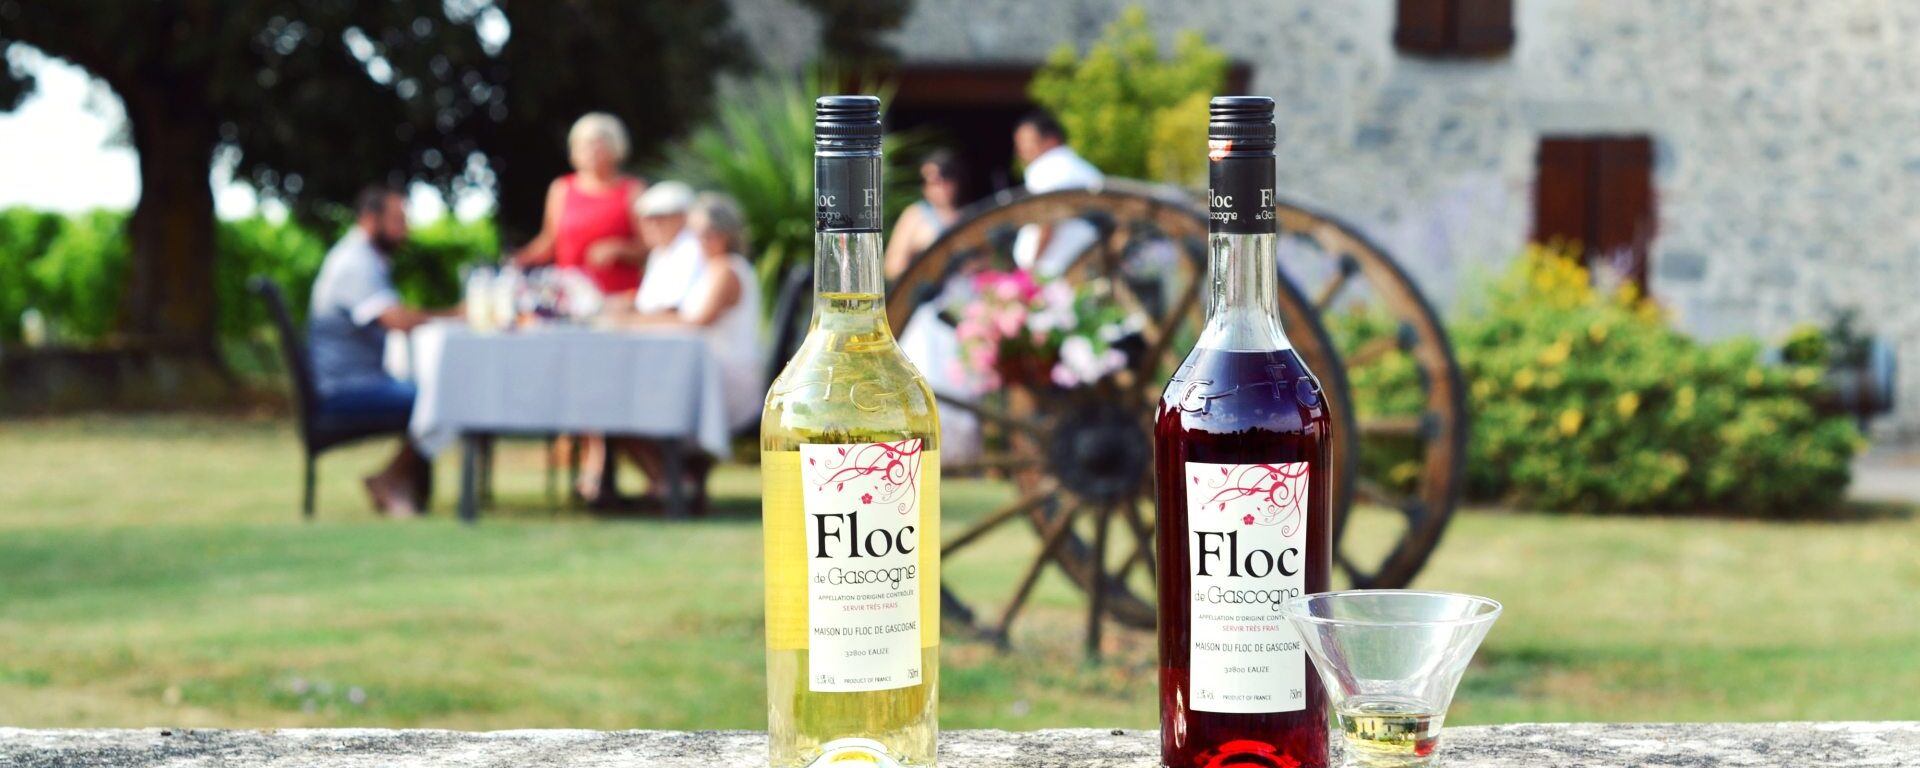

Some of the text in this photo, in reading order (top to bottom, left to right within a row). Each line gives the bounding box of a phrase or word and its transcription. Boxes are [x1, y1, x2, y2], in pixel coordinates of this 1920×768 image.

[812, 510, 915, 559] Floc
[1193, 529, 1299, 578] Floc
[814, 565, 916, 590] de Gascogne
[1194, 590, 1206, 602] de
[842, 604, 865, 612] SERVIR
[814, 621, 917, 636] MAISON DU FLOC DE GASCOGNE
[1195, 641, 1301, 653] MAISON DU FLOC DE GASCOGNE
[845, 650, 867, 658] 32800
[1223, 666, 1246, 674] 32800
